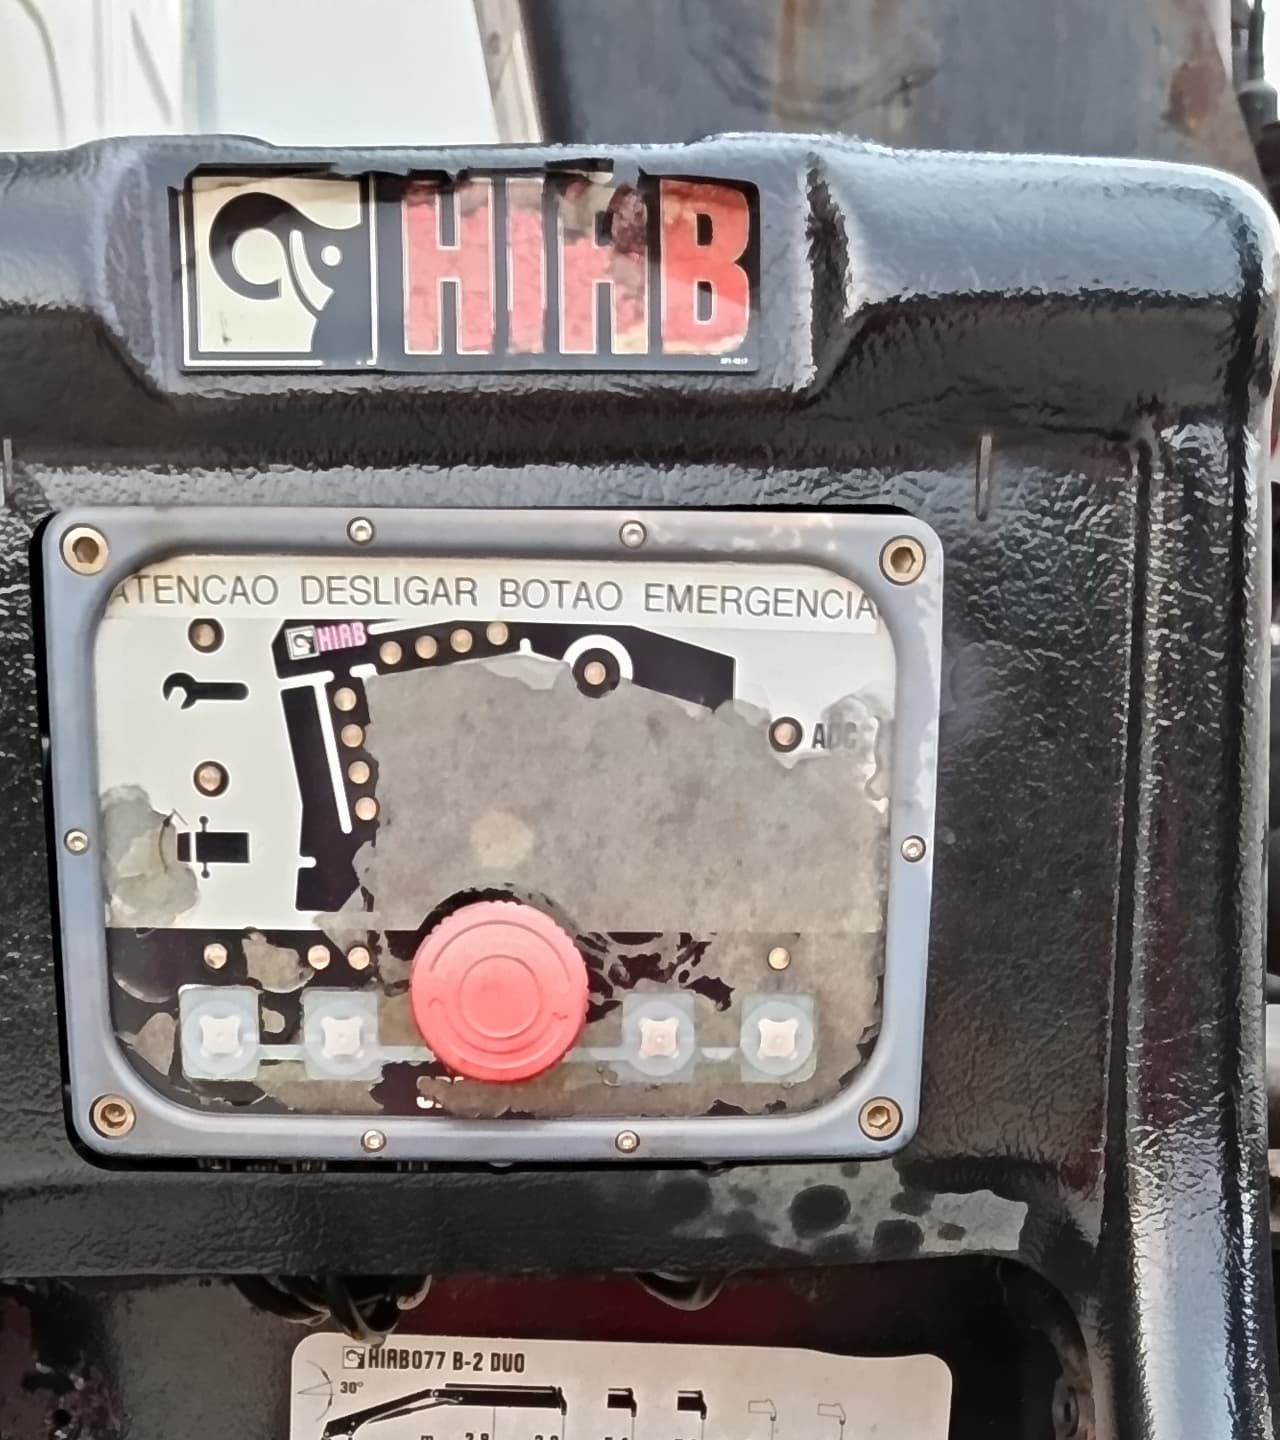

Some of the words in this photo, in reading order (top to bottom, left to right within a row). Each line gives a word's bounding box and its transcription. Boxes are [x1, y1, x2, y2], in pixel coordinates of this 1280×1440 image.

[401, 175, 752, 355] HIAB
[300, 574, 478, 606] DESLIGAR
[499, 577, 624, 612] BOTAO
[643, 582, 881, 620] EMERGENCIA
[317, 622, 366, 652] HIAB
[452, 1351, 483, 1371] B-2
[490, 1352, 526, 1374] DUO
